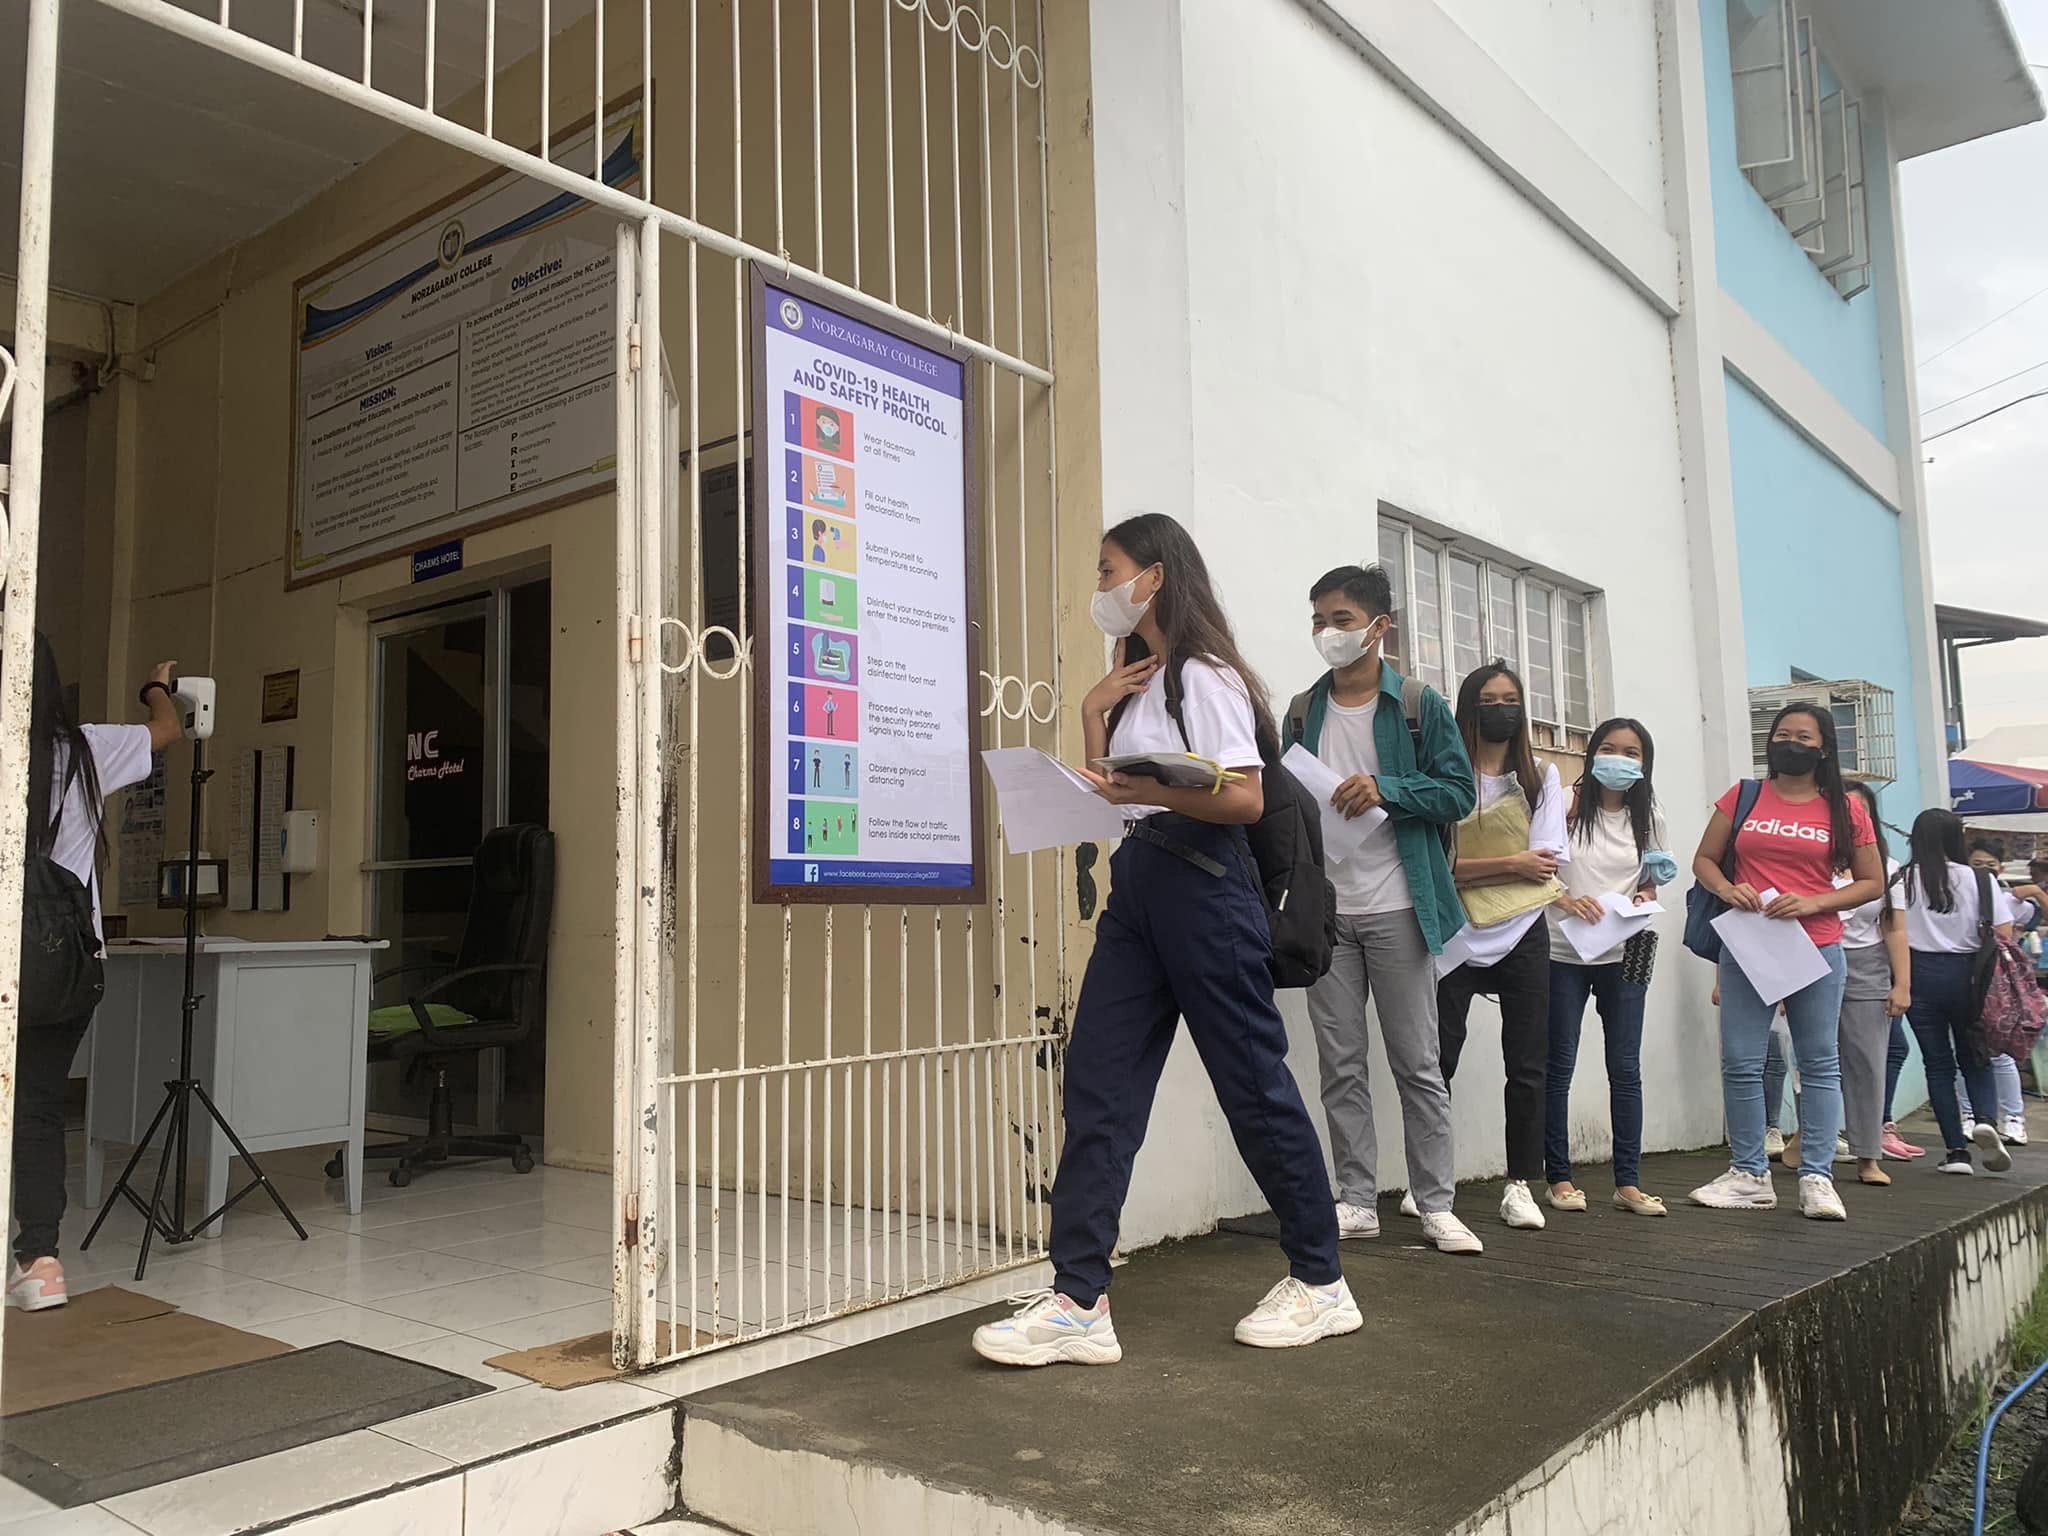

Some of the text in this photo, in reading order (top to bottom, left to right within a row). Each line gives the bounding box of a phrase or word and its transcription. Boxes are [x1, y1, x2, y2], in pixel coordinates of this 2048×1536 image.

[411, 272, 458, 304] NORZAGARAY
[460, 254, 493, 279] COLLEGE
[512, 258, 562, 291] Objective:
[365, 341, 393, 360] Vision:
[811, 316, 937, 377] NORZAGARAY COLLEGE
[813, 357, 929, 413] COVID-19 HEALTH
[360, 385, 396, 411] MISSION:
[793, 367, 947, 436] AND SAFETY PROTOCOL
[790, 412, 795, 425] 1
[863, 431, 915, 457] Wear facemask
[863, 443, 900, 463] at all times
[791, 470, 797, 483] 2
[864, 489, 909, 511] Fill out health
[864, 500, 920, 525] declaration form
[791, 526, 798, 540] 3
[414, 551, 460, 573] CHARMS HOTEL
[865, 541, 923, 564] Submit yourself to
[865, 552, 937, 580] temperature scanning
[792, 584, 799, 597] 4
[866, 596, 955, 624] Disinfect your hands prior to
[866, 608, 949, 635] enter the school premises
[792, 641, 799, 655] 5
[867, 656, 906, 671] Step on the
[867, 667, 936, 687] disinfectant foot mat
[792, 700, 799, 713] 6
[868, 701, 932, 718] Proceed only when
[868, 713, 940, 732] the security personnel
[868, 724, 933, 741] signals you to enter
[407, 730, 438, 761] NC
[408, 759, 464, 781] Charms Hotel
[793, 758, 800, 771] 7
[868, 762, 926, 779] Observe physical
[868, 774, 904, 787] distancing
[793, 816, 800, 829] 8
[868, 817, 947, 830] Follow the flow of traffic
[1743, 819, 1830, 842] adidas
[868, 828, 960, 844] lanes inside school premises
